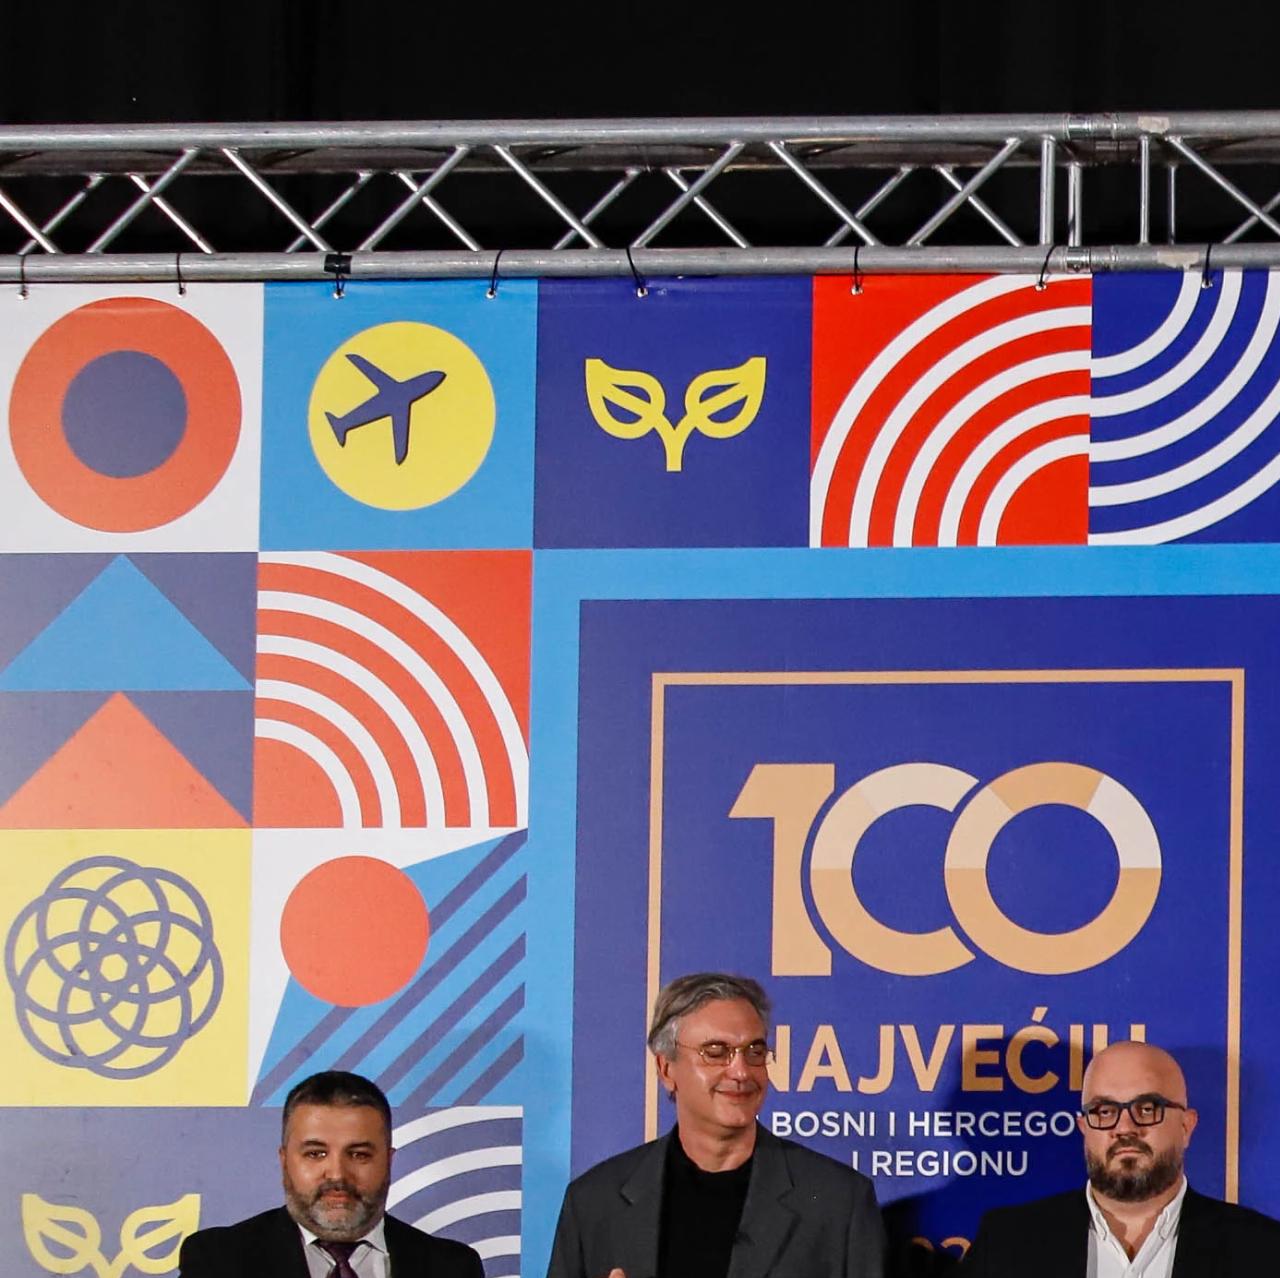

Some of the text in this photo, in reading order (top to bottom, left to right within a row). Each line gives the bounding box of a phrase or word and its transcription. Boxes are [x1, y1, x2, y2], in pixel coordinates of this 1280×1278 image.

[727, 761, 1162, 976] 100
[772, 1111, 1083, 1137] BOSNI I HERCEGO
[872, 1151, 1028, 1176] REGIONU
